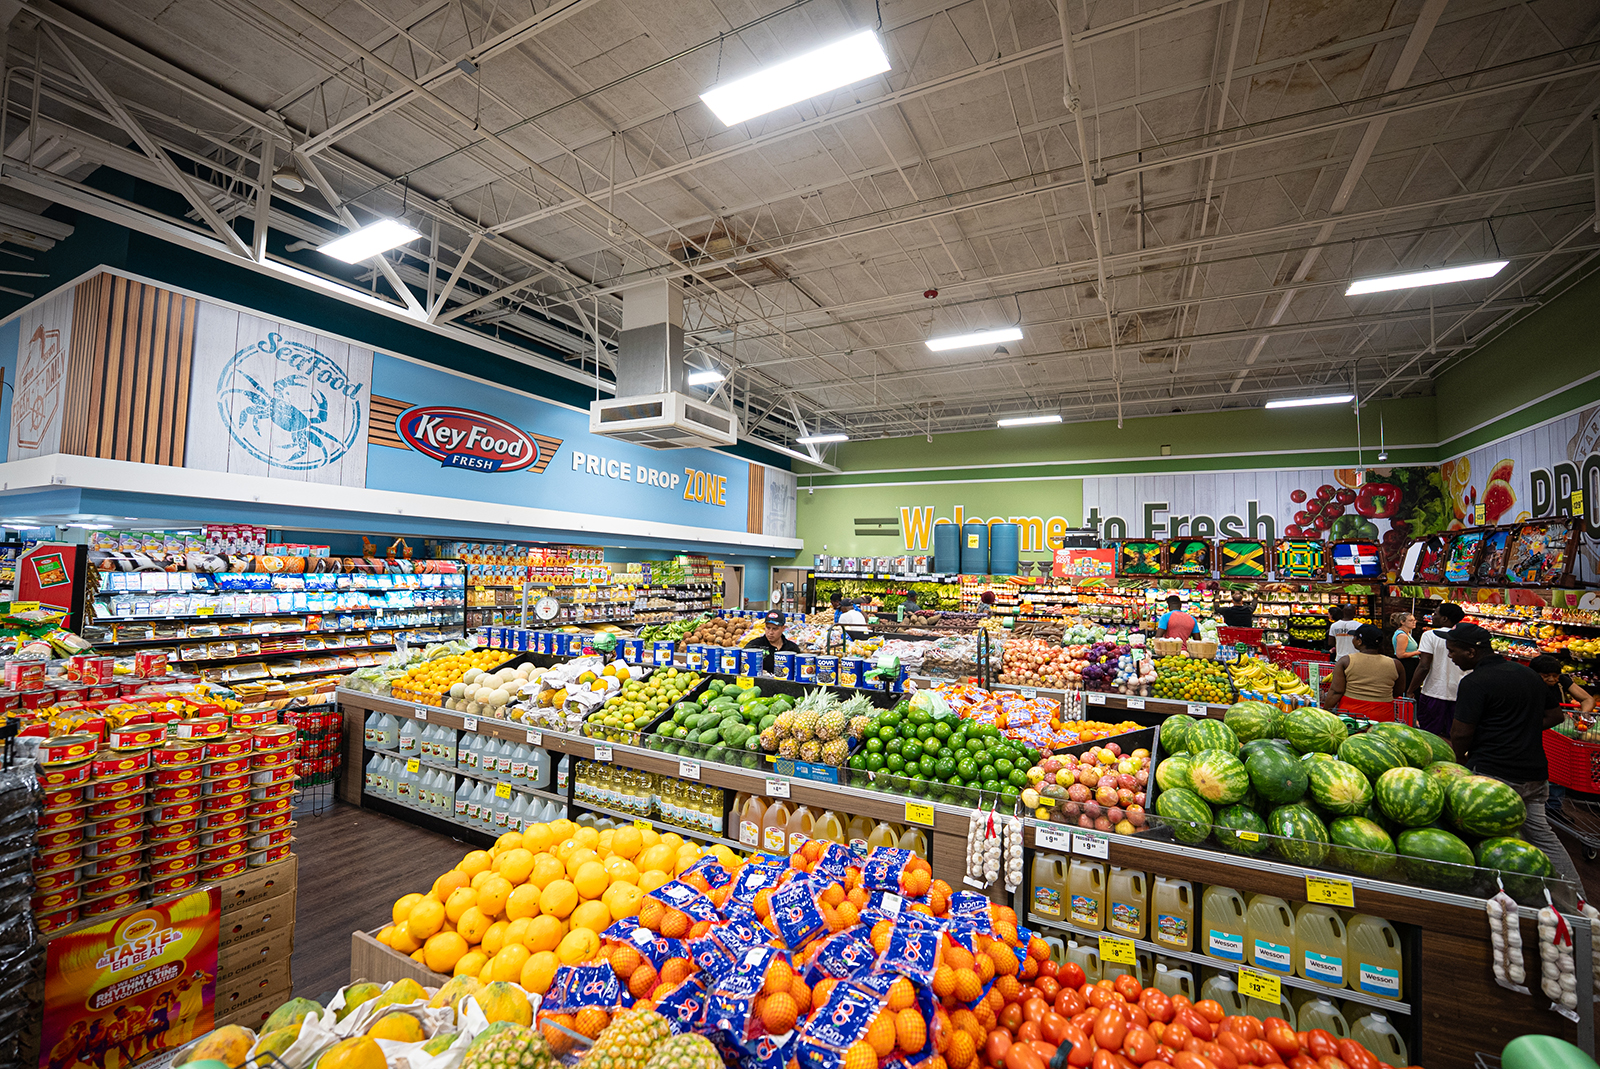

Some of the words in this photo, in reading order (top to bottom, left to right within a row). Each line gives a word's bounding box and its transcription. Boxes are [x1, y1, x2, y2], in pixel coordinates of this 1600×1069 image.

[45, 349, 66, 392] DAILY
[414, 414, 467, 449] Key
[465, 425, 524, 458] Food
[452, 455, 494, 470] FRESH
[572, 451, 631, 482] PRICE
[636, 465, 680, 490] DROP
[683, 467, 728, 507] ZONE
[900, 505, 1069, 552] Wlme
[1142, 500, 1276, 549] Fresh
[236, 891, 268, 906] CHEESE
[780, 887, 804, 905] LUCKY
[233, 926, 266, 942] CHEESE
[1213, 938, 1238, 948] Wesson
[104, 928, 173, 963] TASTE
[1259, 948, 1285, 960] Wesson
[112, 958, 129, 972] EH
[132, 945, 165, 964] BEAT
[235, 957, 267, 975] CHEESE
[1309, 960, 1337, 972] Wesson
[96, 979, 145, 1002] RHYTHM
[154, 965, 178, 979] TINS
[128, 973, 148, 984] HAVE
[149, 968, 161, 976] THE
[1365, 972, 1394, 984] Wesson
[96, 997, 114, 1008] FOR
[115, 990, 133, 1000] YOU
[133, 985, 147, 995] ALL
[231, 992, 264, 1011] CHEESE
